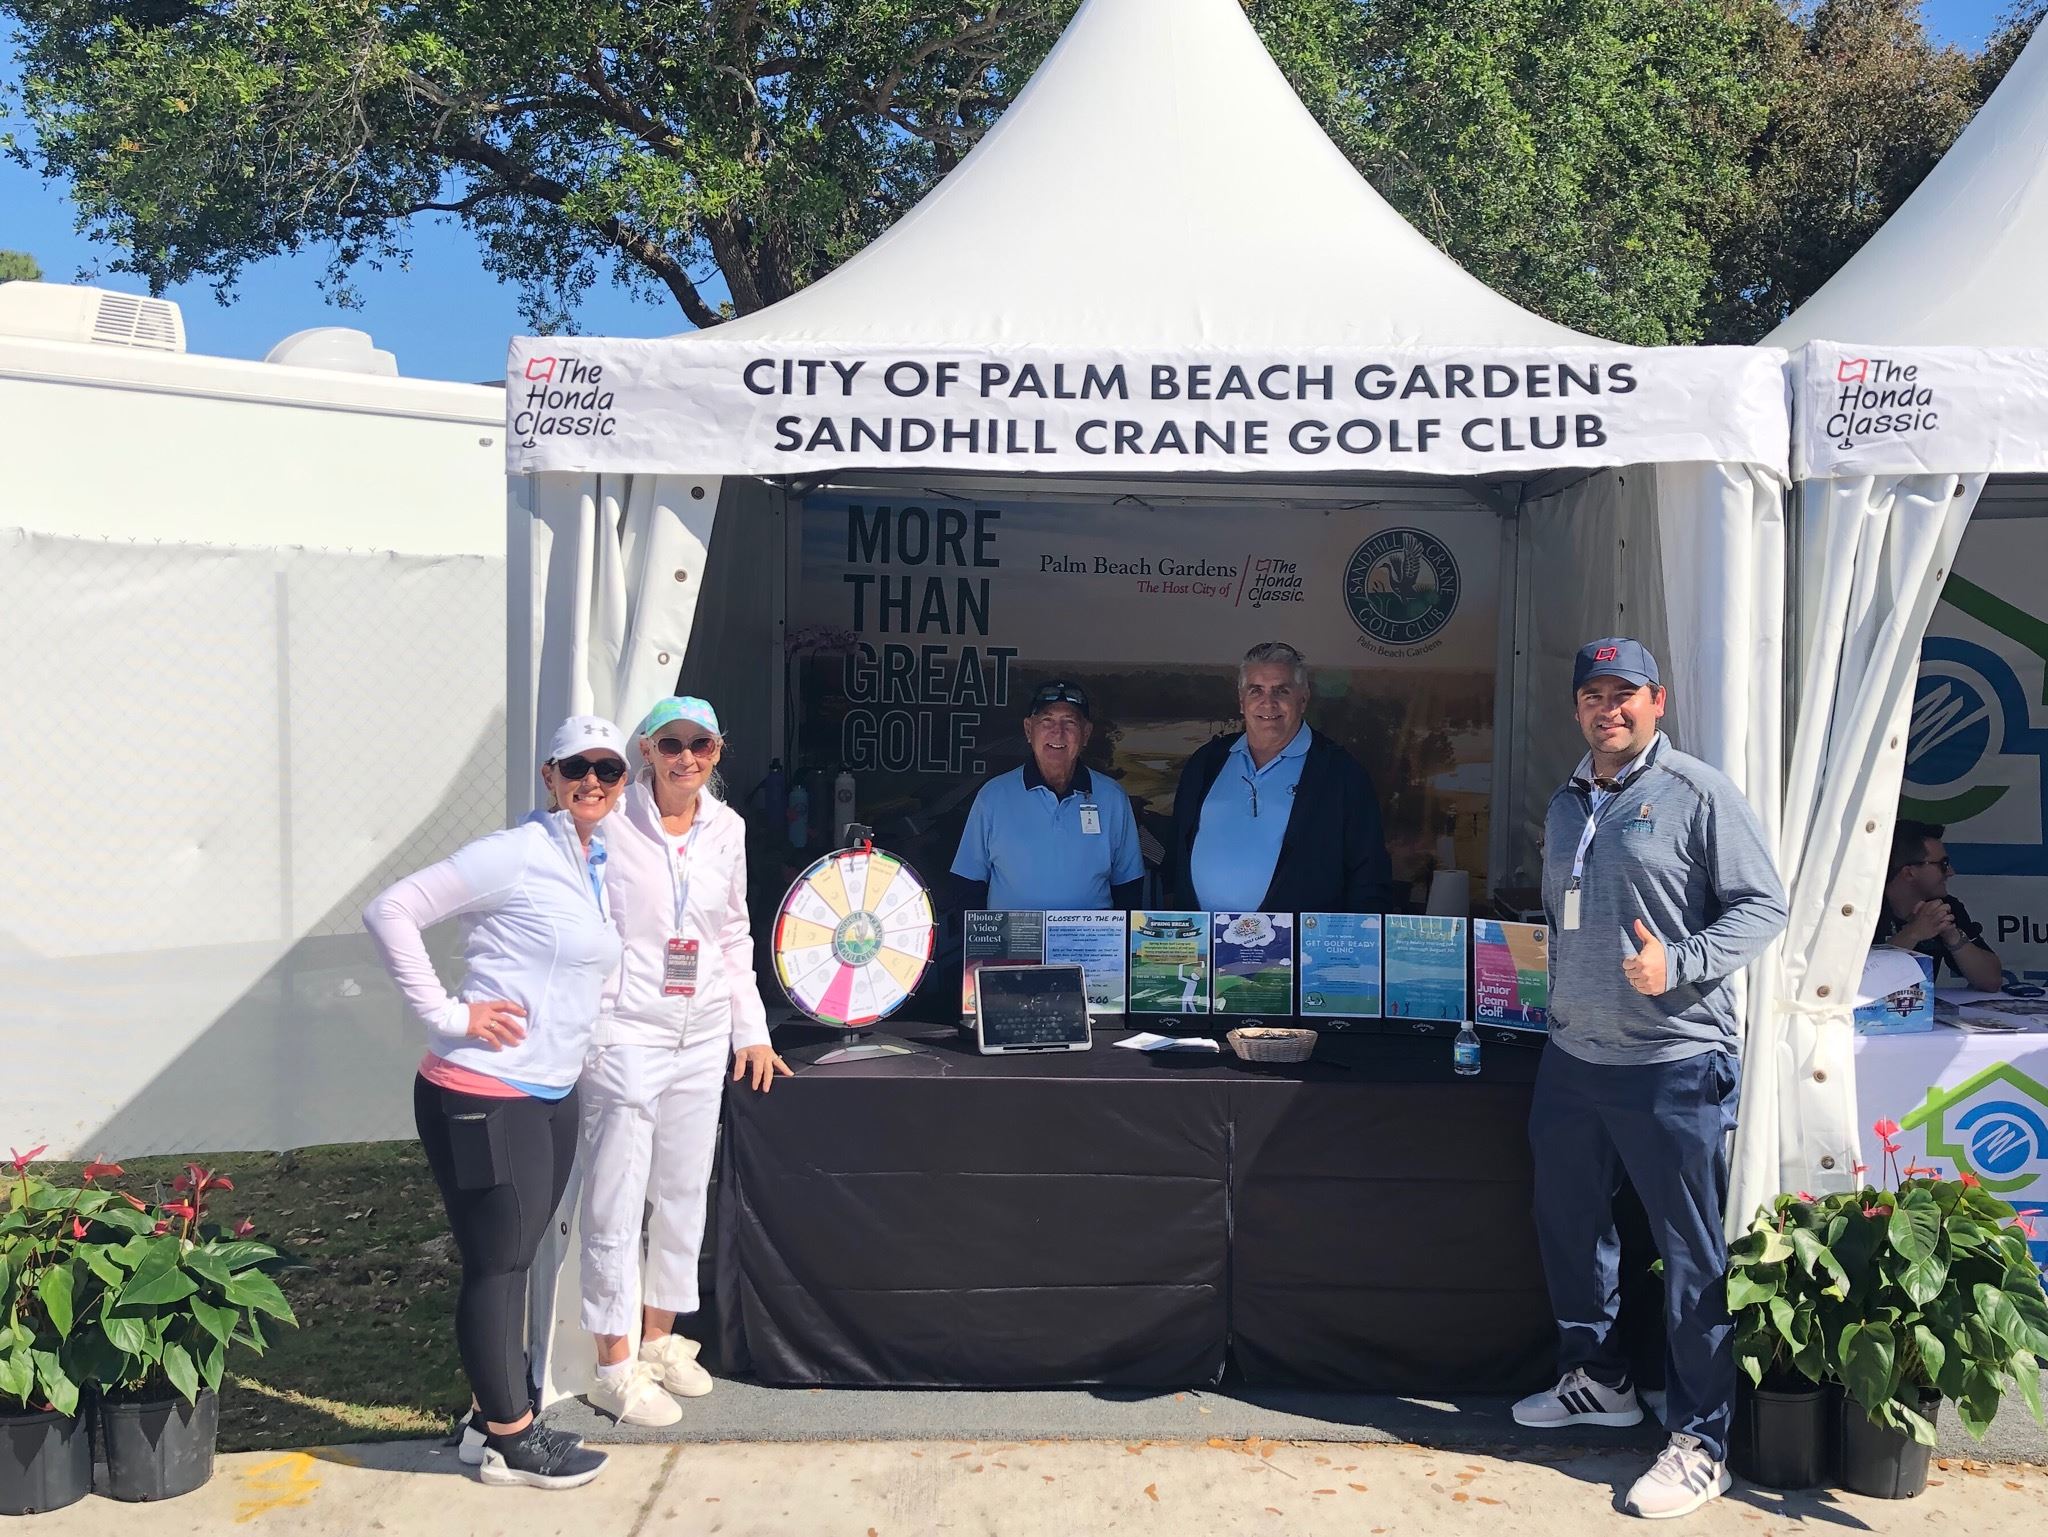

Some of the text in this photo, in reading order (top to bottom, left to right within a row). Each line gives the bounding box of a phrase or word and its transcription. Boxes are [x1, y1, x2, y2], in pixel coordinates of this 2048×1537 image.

[558, 358, 603, 384] The
[743, 358, 1638, 400] CITY OF PALM BEACH GARDENS
[1870, 360, 1918, 383] The
[526, 384, 615, 410] Honda
[1839, 384, 1933, 411] Honda
[514, 410, 616, 436] Classic
[774, 412, 1608, 455] SANDHILL CRANE GOLF CLUB
[1826, 409, 1938, 438] Classic
[847, 505, 1002, 568] MORE
[1039, 554, 1238, 578] Palm Beach Gardens
[1272, 559, 1297, 574] The
[1350, 533, 1455, 596] SANDHILL CRANE
[1137, 580, 1232, 597] The Host City of
[1255, 573, 1303, 588] Honda
[843, 573, 990, 636] THAN
[1248, 587, 1303, 601] Classic
[1358, 607, 1445, 638] GOLF CLUB
[1356, 635, 1443, 658] Palm Beach Gardens
[843, 642, 1019, 707] GREAT
[842, 708, 986, 774] GOLF.
[967, 912, 993, 922] Photo
[994, 913, 1004, 922] &
[973, 923, 998, 932] Video
[1047, 914, 1081, 922] CLOSEST
[1095, 914, 1109, 922] THE
[968, 934, 1002, 943] Contest
[1477, 981, 1511, 995] Junior
[1477, 992, 1508, 1007] Team
[1478, 1004, 1504, 1018] Golf!
